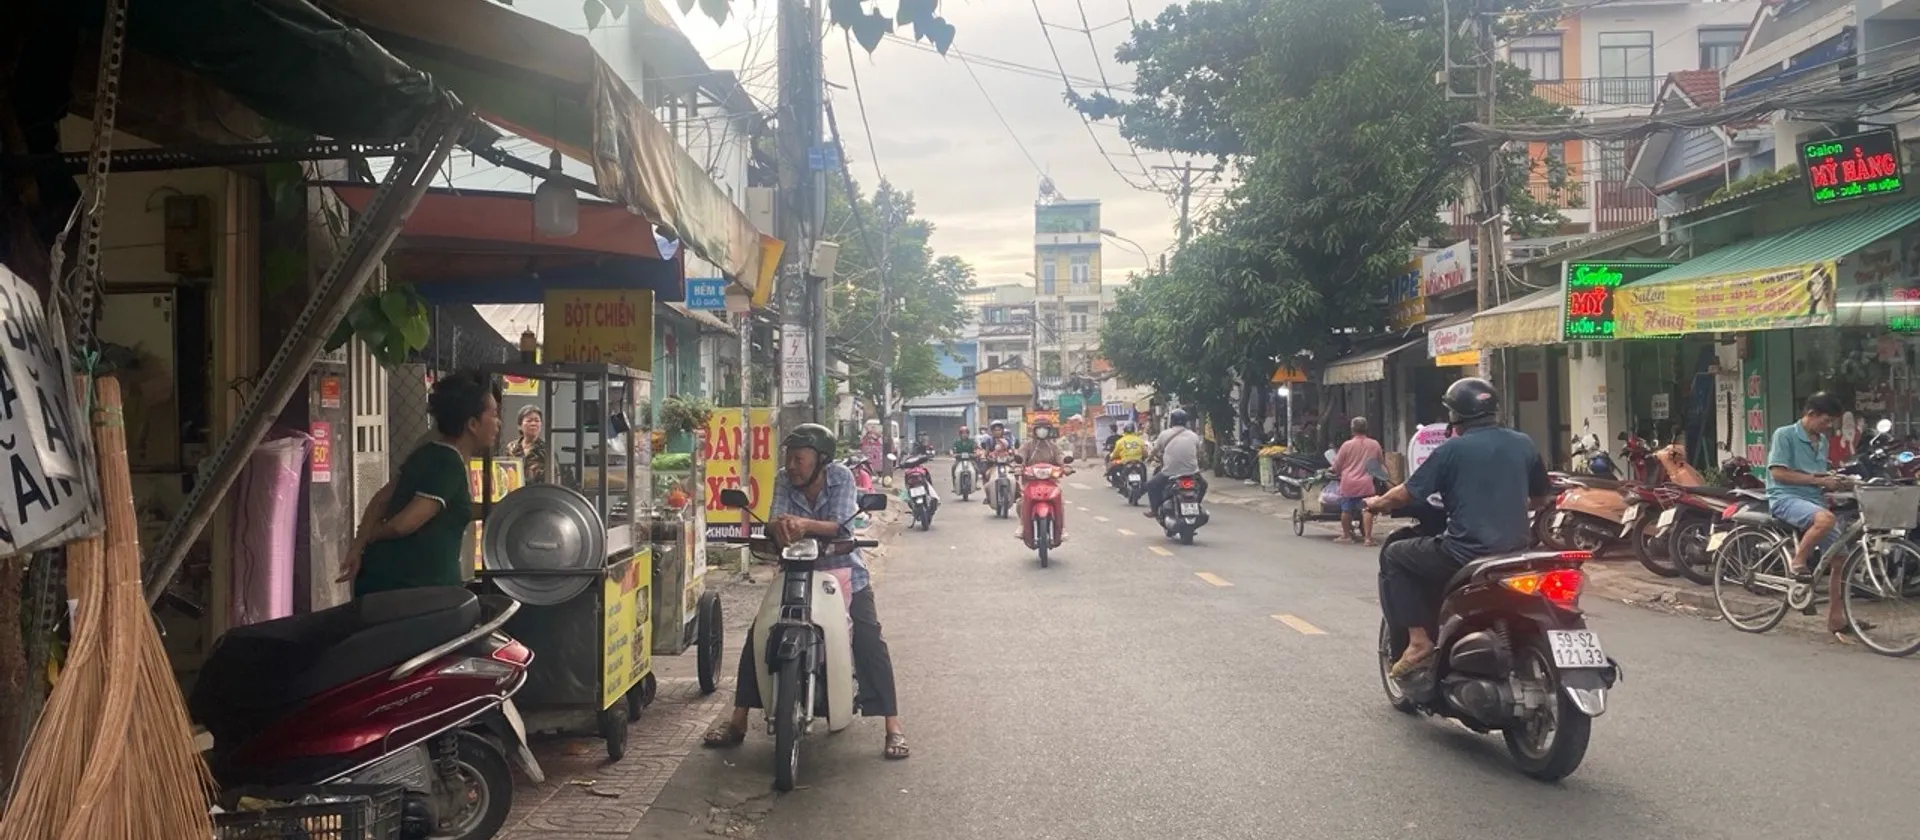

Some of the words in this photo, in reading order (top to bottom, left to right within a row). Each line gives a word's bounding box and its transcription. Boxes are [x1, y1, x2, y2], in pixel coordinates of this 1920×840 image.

[1807, 144, 1844, 158] Salon
[564, 297, 592, 334] BỘT
[1556, 633, 1596, 648] 59-S2
[1556, 649, 1603, 665] 121.33
